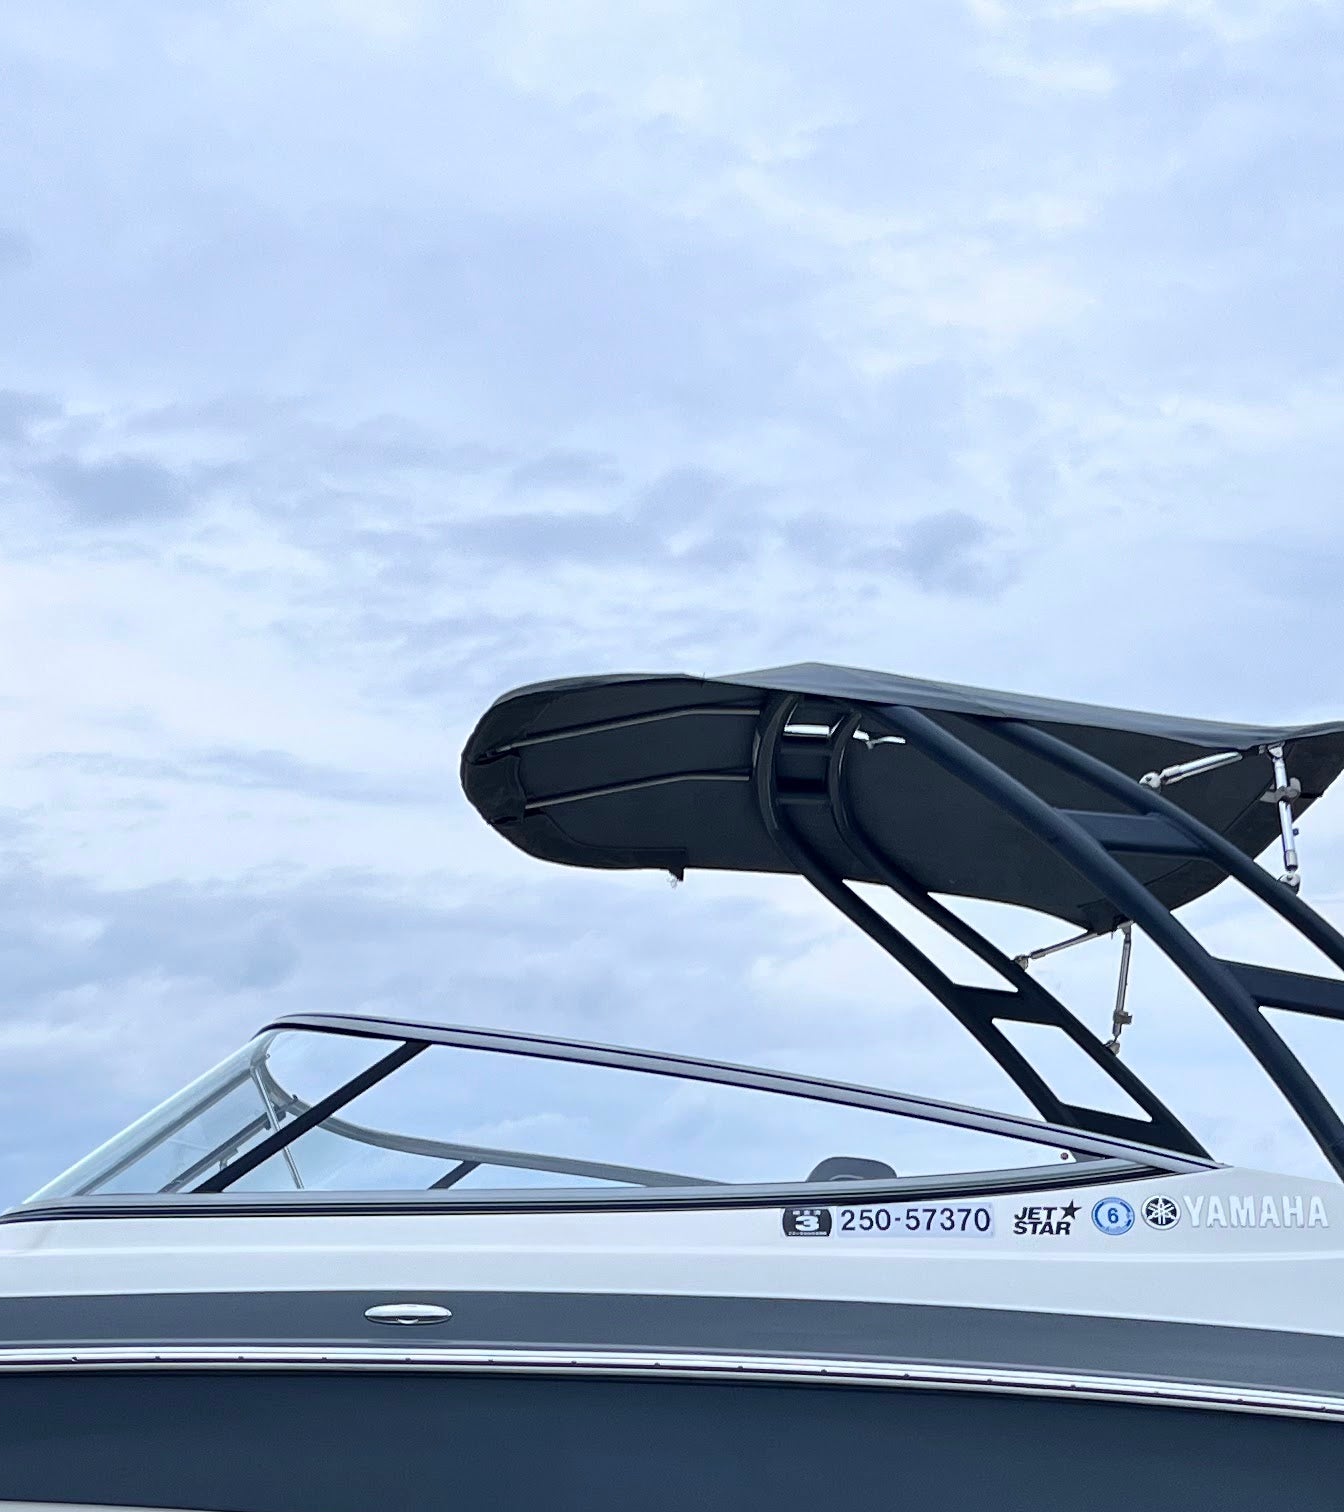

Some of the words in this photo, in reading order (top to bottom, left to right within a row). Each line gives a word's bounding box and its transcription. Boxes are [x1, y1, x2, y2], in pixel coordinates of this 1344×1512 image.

[840, 1208, 991, 1231] 250-57370
[1014, 1207, 1057, 1220] JET
[1107, 1207, 1119, 1224] 6
[1183, 1195, 1329, 1228] YAMAHA
[1013, 1221, 1070, 1235] STAR
